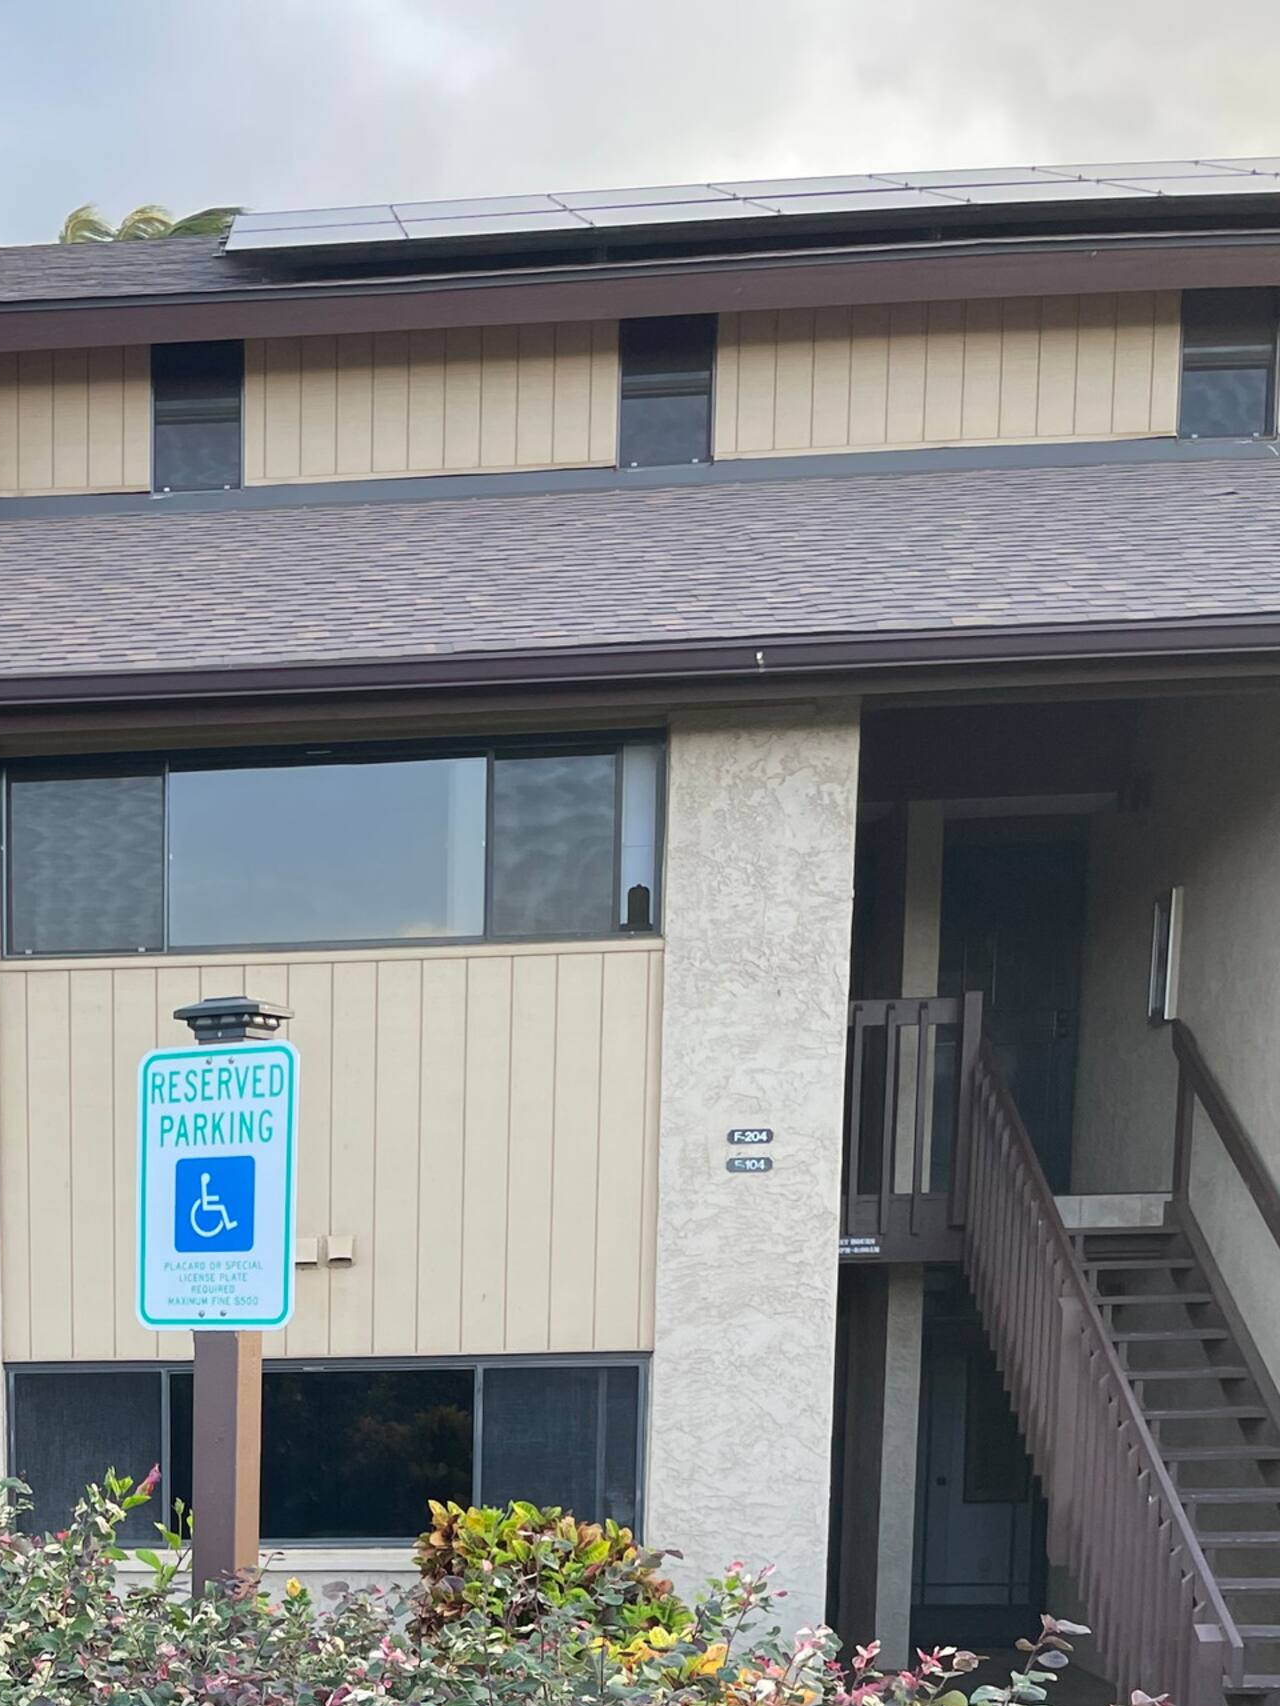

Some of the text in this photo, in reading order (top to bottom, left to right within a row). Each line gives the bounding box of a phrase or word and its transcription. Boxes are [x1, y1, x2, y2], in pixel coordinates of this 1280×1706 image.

[151, 1063, 285, 1104] RESERVED
[159, 1109, 274, 1148] PARKING
[734, 1131, 768, 1142] F-204
[163, 1260, 263, 1272] PLACARD OR SPECIAL
[179, 1272, 248, 1283] LICENSE PLATE
[191, 1284, 235, 1294] REQUIRED
[168, 1295, 259, 1306] MAXIMUM FINE $500
